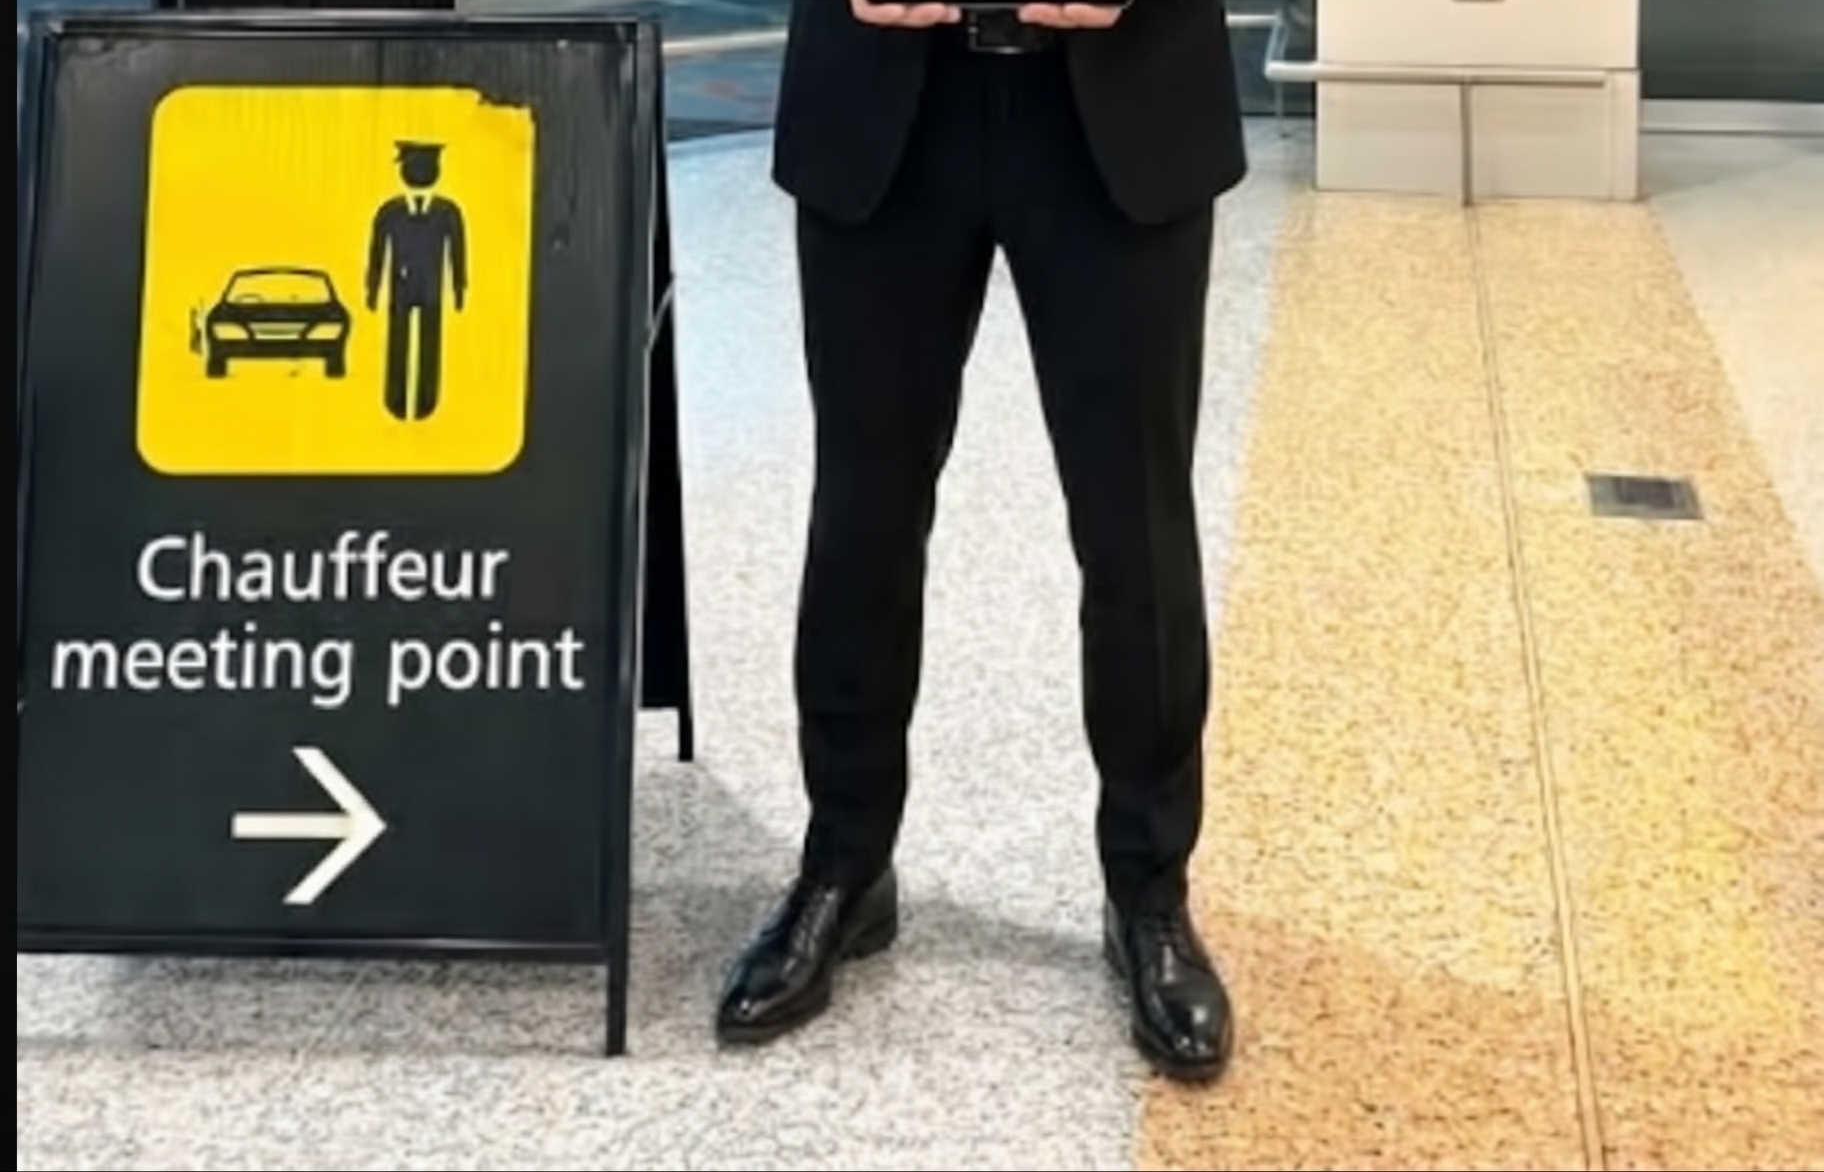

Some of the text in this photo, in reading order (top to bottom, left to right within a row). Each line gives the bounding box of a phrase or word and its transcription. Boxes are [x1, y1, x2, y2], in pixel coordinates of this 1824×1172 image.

[136, 530, 510, 602] Chauffeur
[50, 621, 585, 708] meeting point
